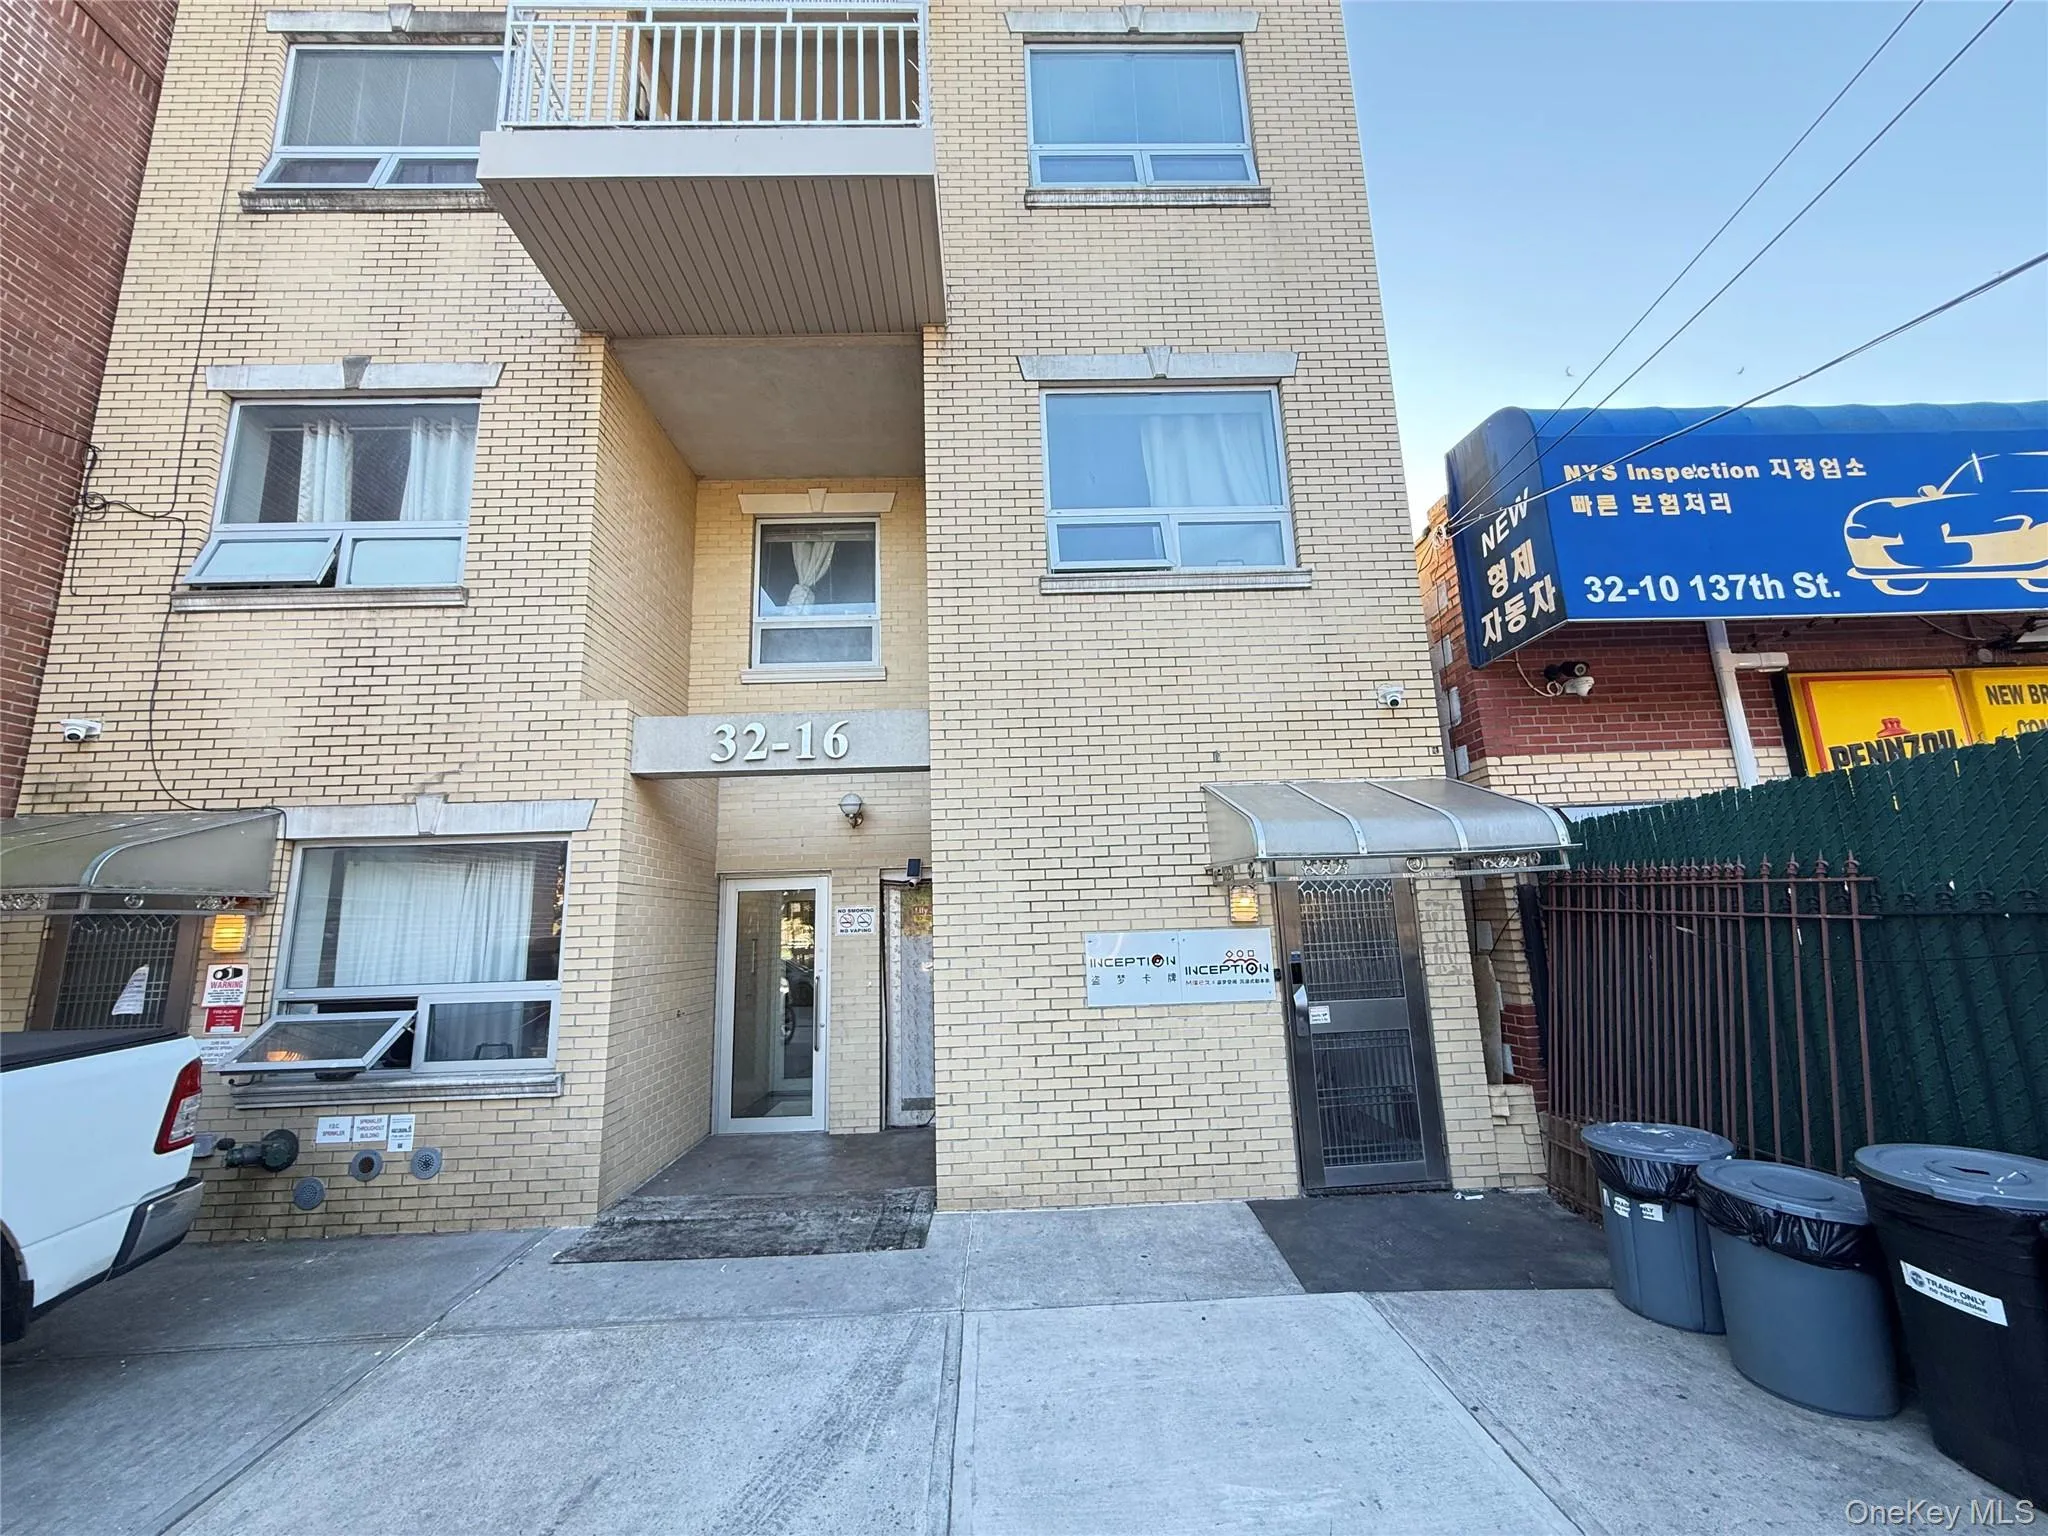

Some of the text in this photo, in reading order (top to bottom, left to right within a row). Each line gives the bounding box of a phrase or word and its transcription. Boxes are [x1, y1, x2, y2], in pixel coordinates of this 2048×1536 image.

[1563, 457, 1867, 483] NYS Inspection 지정업소
[1570, 492, 1732, 517] 빠른 보험처리
[1481, 487, 1529, 558] NEW
[1487, 538, 1537, 599] 형제
[1583, 571, 1841, 603] 32-10 137th St.
[1481, 574, 1556, 648] 자동차
[1985, 684, 2024, 705] NEW
[710, 719, 850, 762] 32-16
[1089, 954, 1176, 968] INCEPTION
[1185, 962, 1270, 976] INCEPTION
[211, 981, 243, 989] WARNING
[1925, 1277, 1986, 1306] TRASH ONLY
[1929, 1287, 1939, 1295] no
[1940, 1291, 1988, 1314] recyclables
